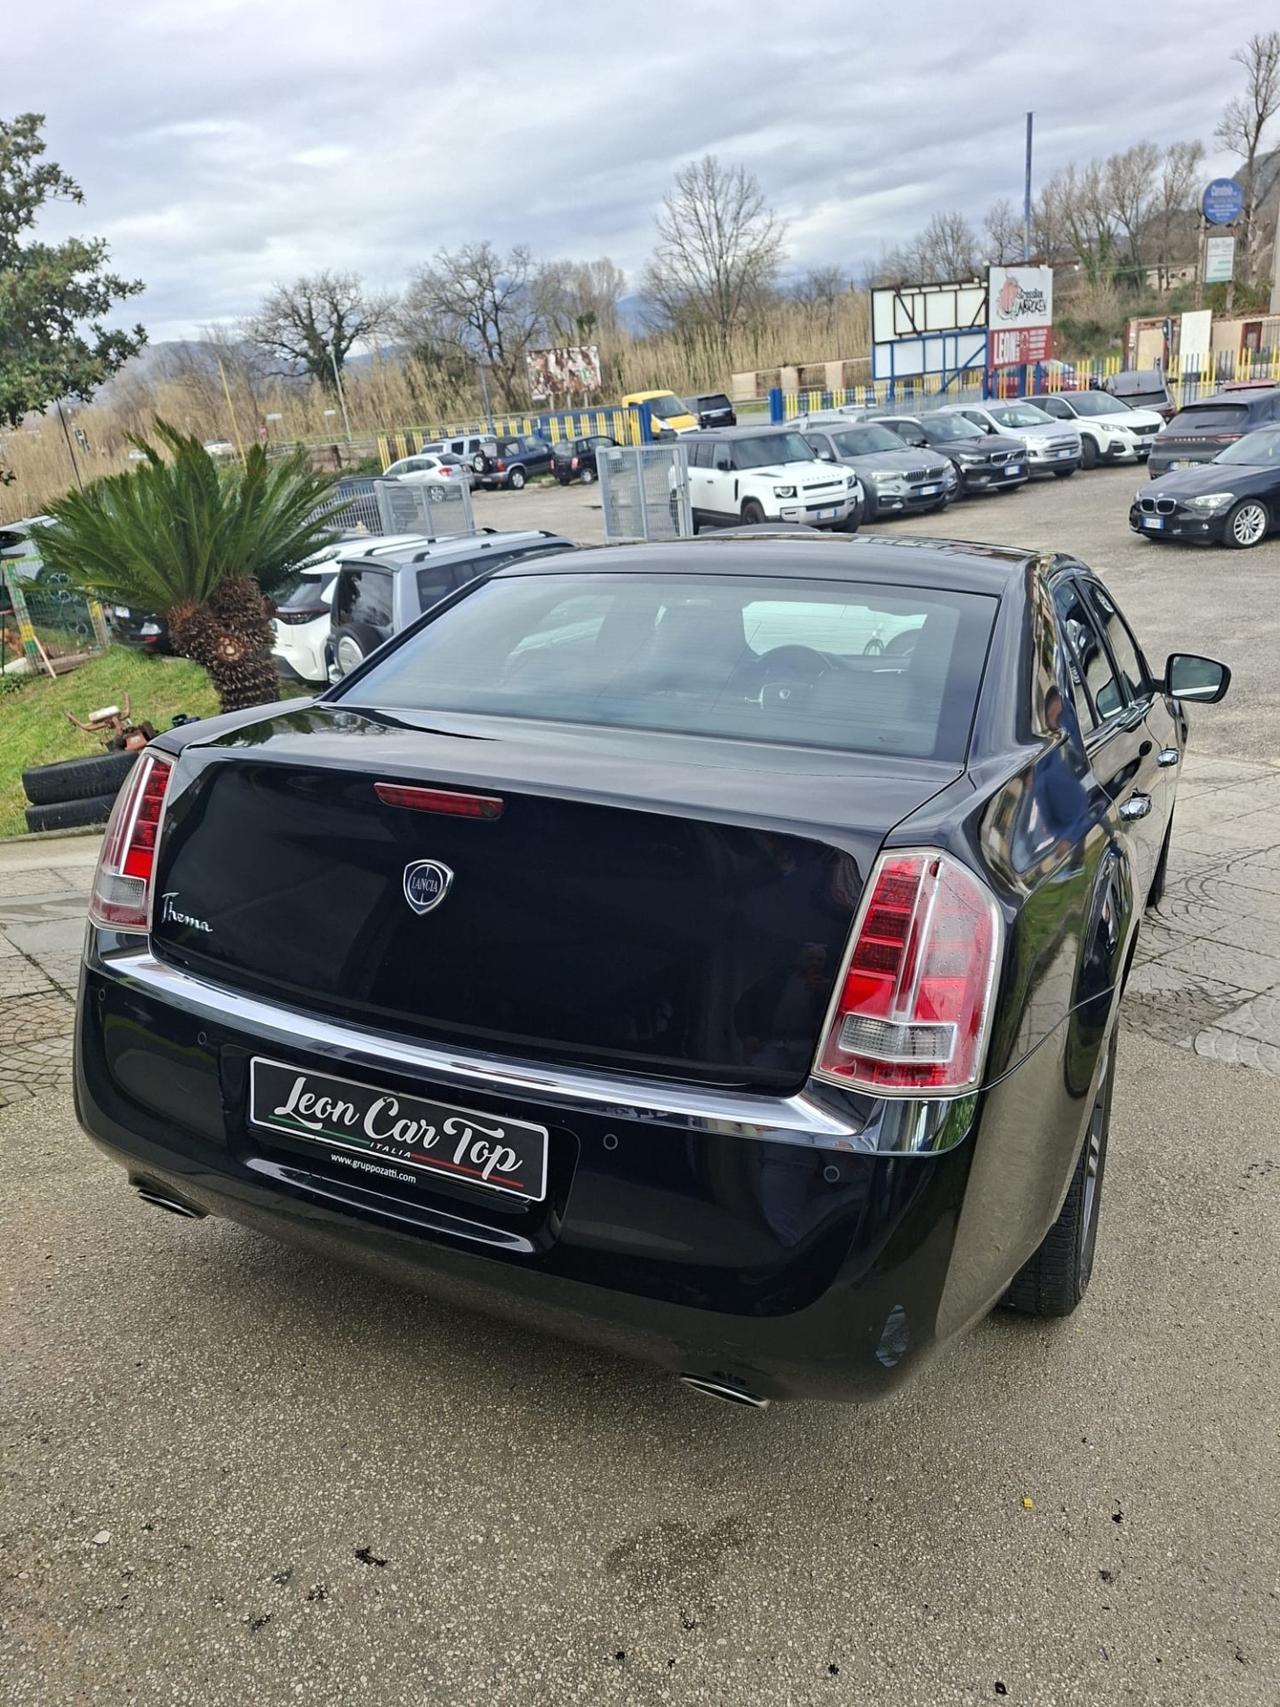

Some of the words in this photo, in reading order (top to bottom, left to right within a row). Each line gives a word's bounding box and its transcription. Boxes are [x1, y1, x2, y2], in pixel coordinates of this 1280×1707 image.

[411, 876, 438, 893] LANCIA
[161, 892, 214, 932] Thema
[273, 1076, 360, 1131] Leon
[363, 1096, 441, 1149] Car
[443, 1116, 523, 1181] Top
[369, 1141, 412, 1159] ITALIA
[330, 1152, 417, 1185] www.gruppozatti.com
